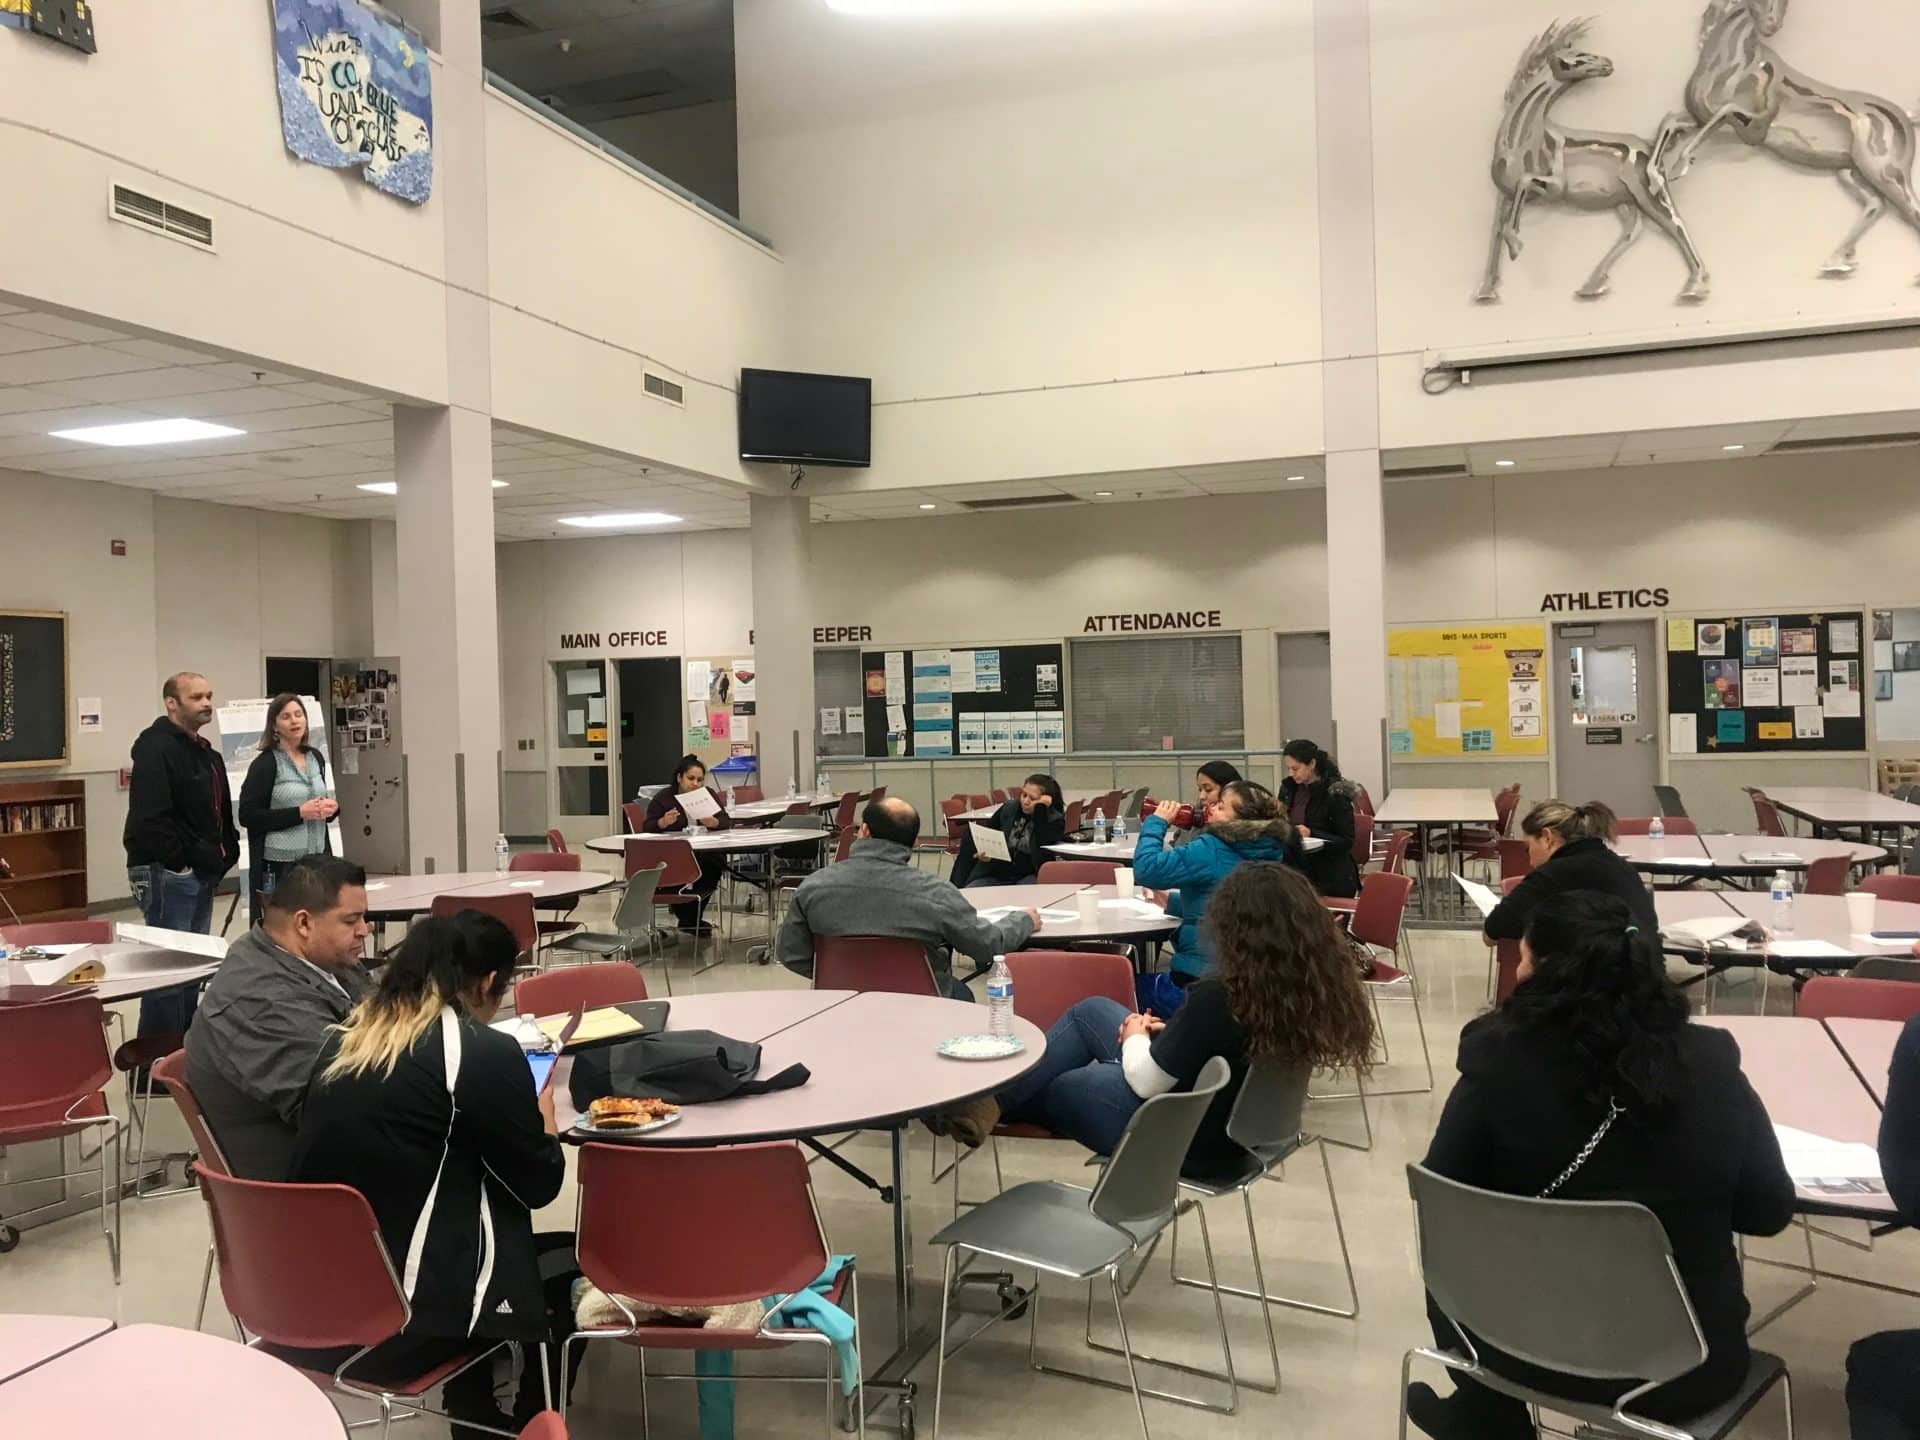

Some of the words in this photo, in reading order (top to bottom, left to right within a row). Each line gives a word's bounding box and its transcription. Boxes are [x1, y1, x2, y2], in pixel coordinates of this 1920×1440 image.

[1540, 588, 1669, 612] ATHLETICS
[1083, 610, 1221, 633] ATTENDANCE
[561, 633, 600, 648] MAIN
[608, 630, 667, 647] OFFICE
[1481, 631, 1507, 640] SPORTS
